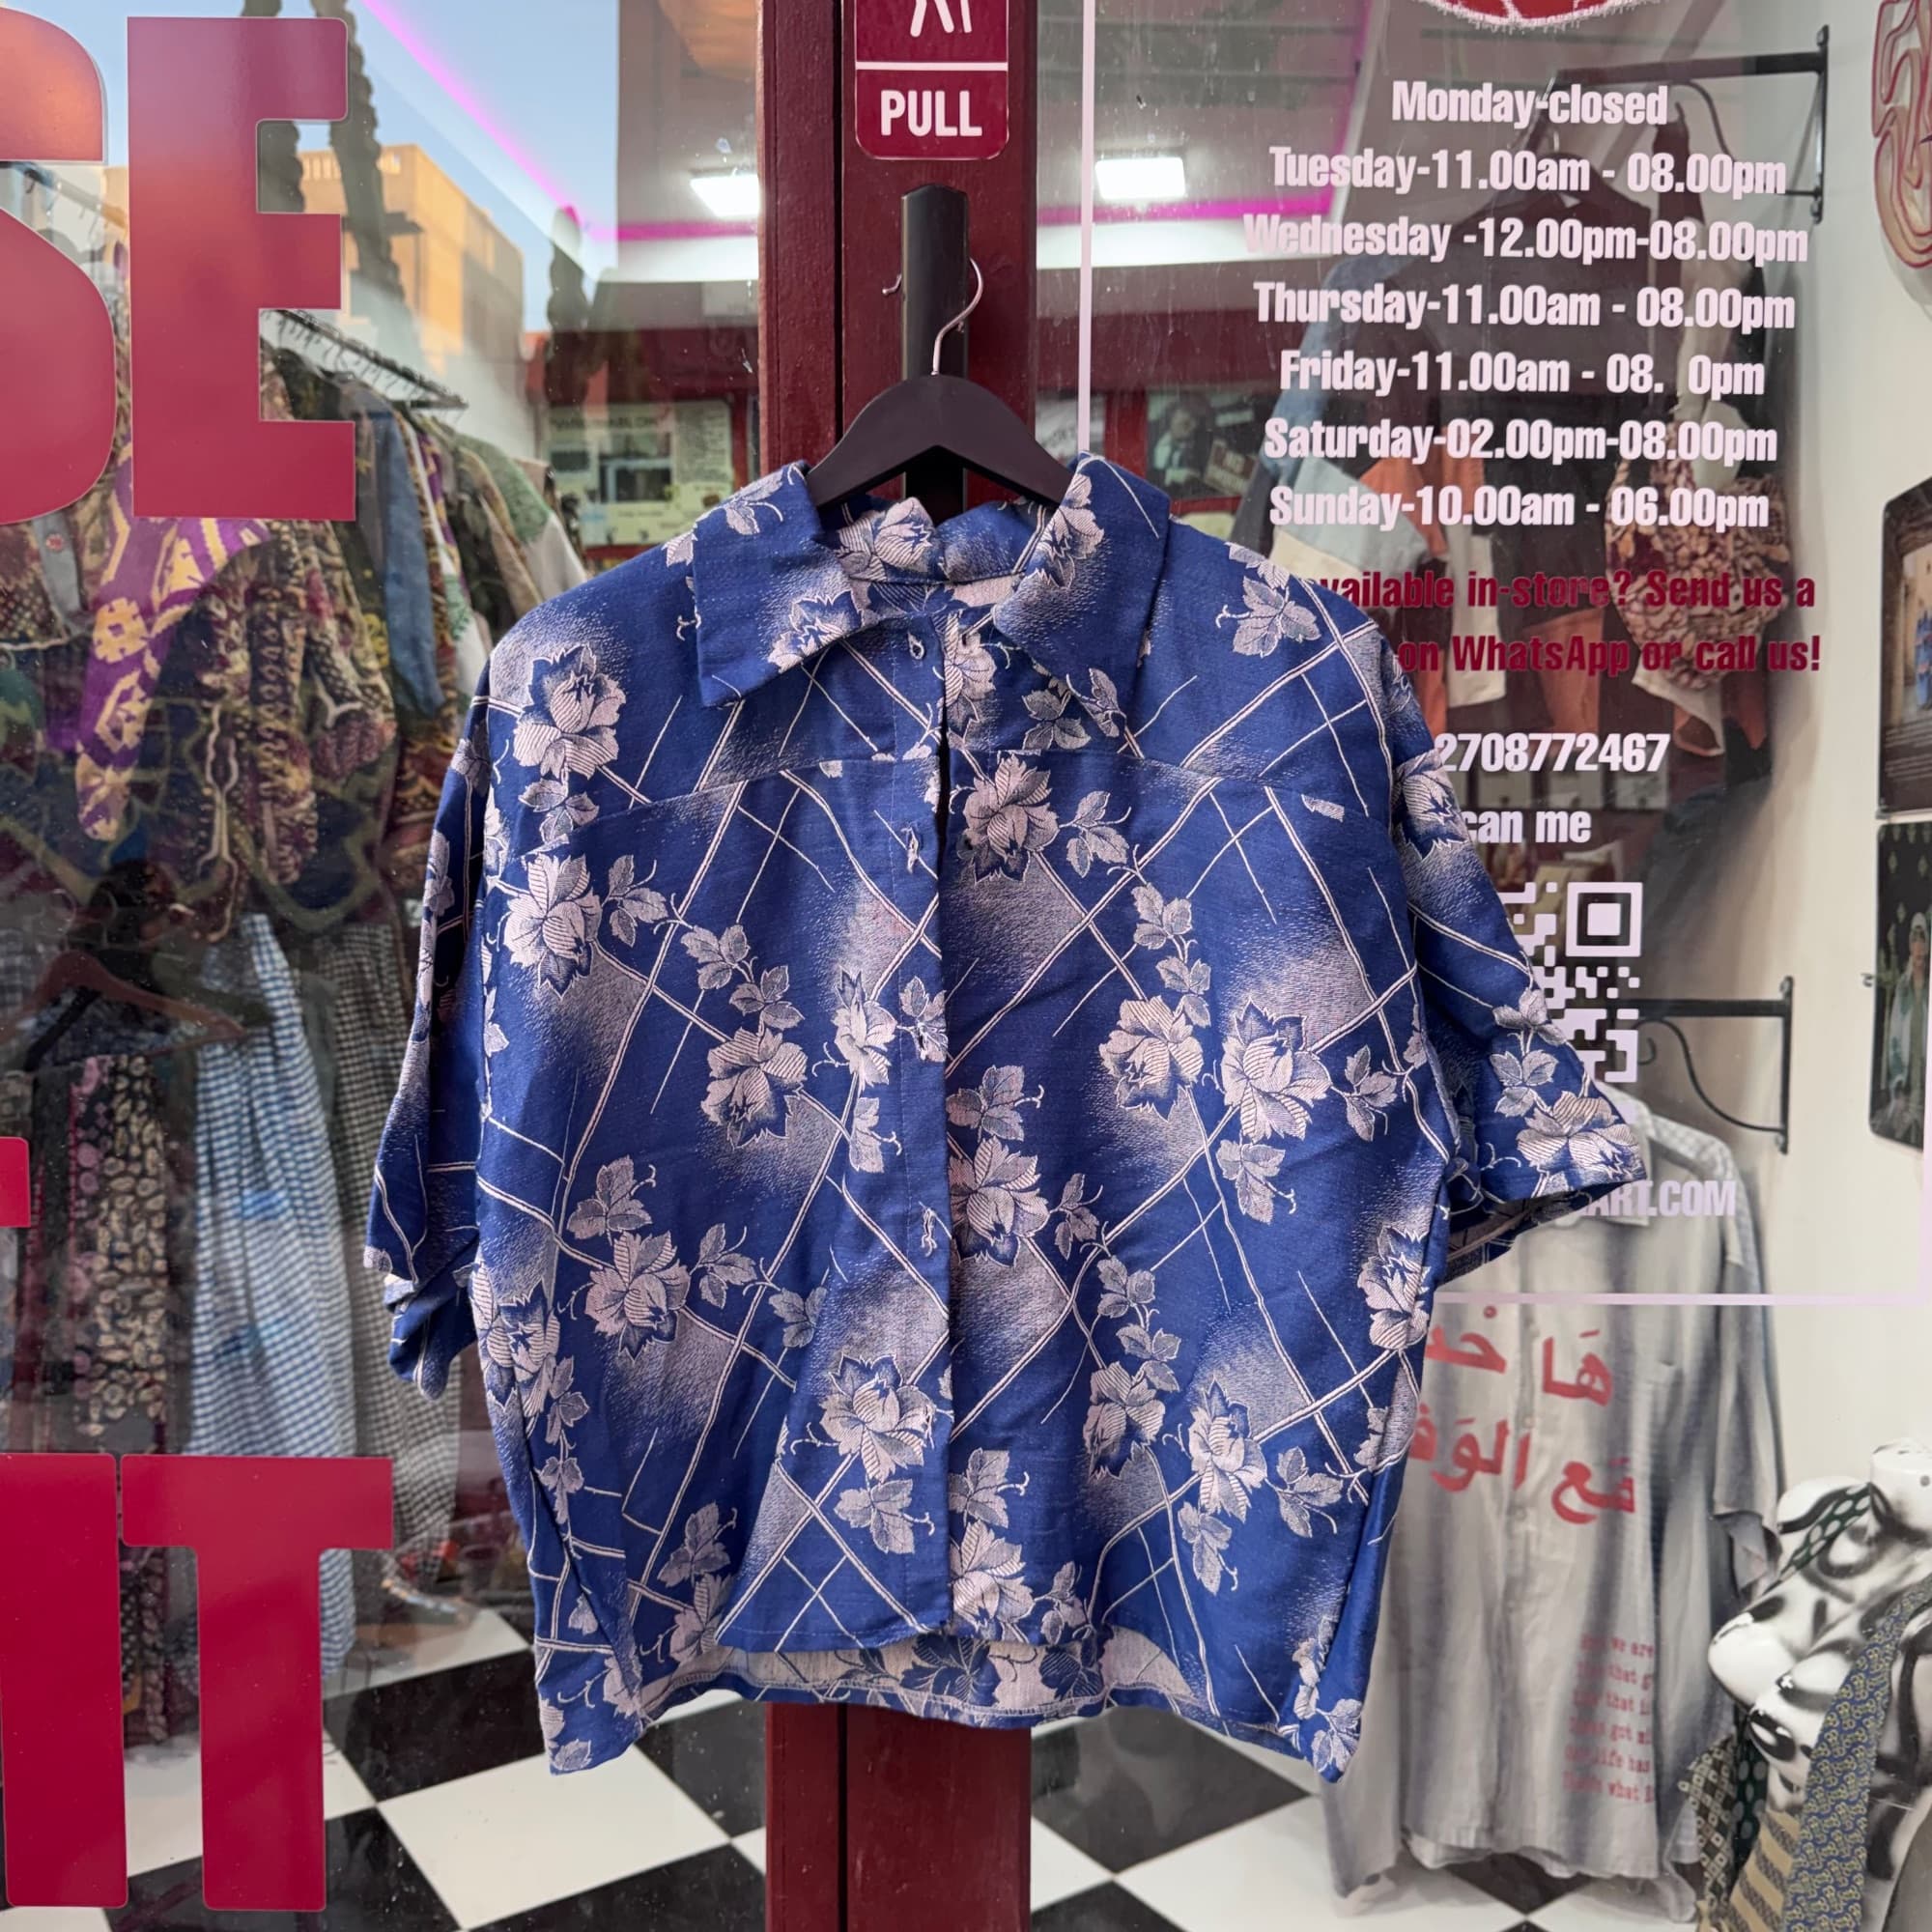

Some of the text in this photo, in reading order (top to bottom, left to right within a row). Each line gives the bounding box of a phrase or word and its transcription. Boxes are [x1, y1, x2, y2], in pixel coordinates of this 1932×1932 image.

[880, 89, 983, 137] PULL
[1392, 80, 1668, 128] Monday-closed
[1269, 145, 1591, 193] Tuesday-11.00am
[1627, 152, 1787, 200] 08.00pm
[1242, 213, 1808, 267] Wednesday -12.00pm-08.00pm
[1252, 280, 1601, 330] Thursday-11.00am
[1635, 287, 1797, 335] 08.00pm
[1280, 349, 1571, 396] Friday-11.00am
[1263, 417, 1778, 466] Saturday-02.00pm-08.00pm
[1269, 485, 1576, 530] Sunday-10.00am
[1609, 485, 1771, 533] 06.00pm
[1467, 571, 1632, 608] in-store?
[1645, 570, 1730, 608] Send
[1743, 578, 1782, 608] us
[1797, 577, 1815, 607] a
[1399, 635, 1821, 676] on WhatsApp or call us!
[1462, 810, 1592, 843] can me
[1579, 1180, 1735, 1216] ART.COM
